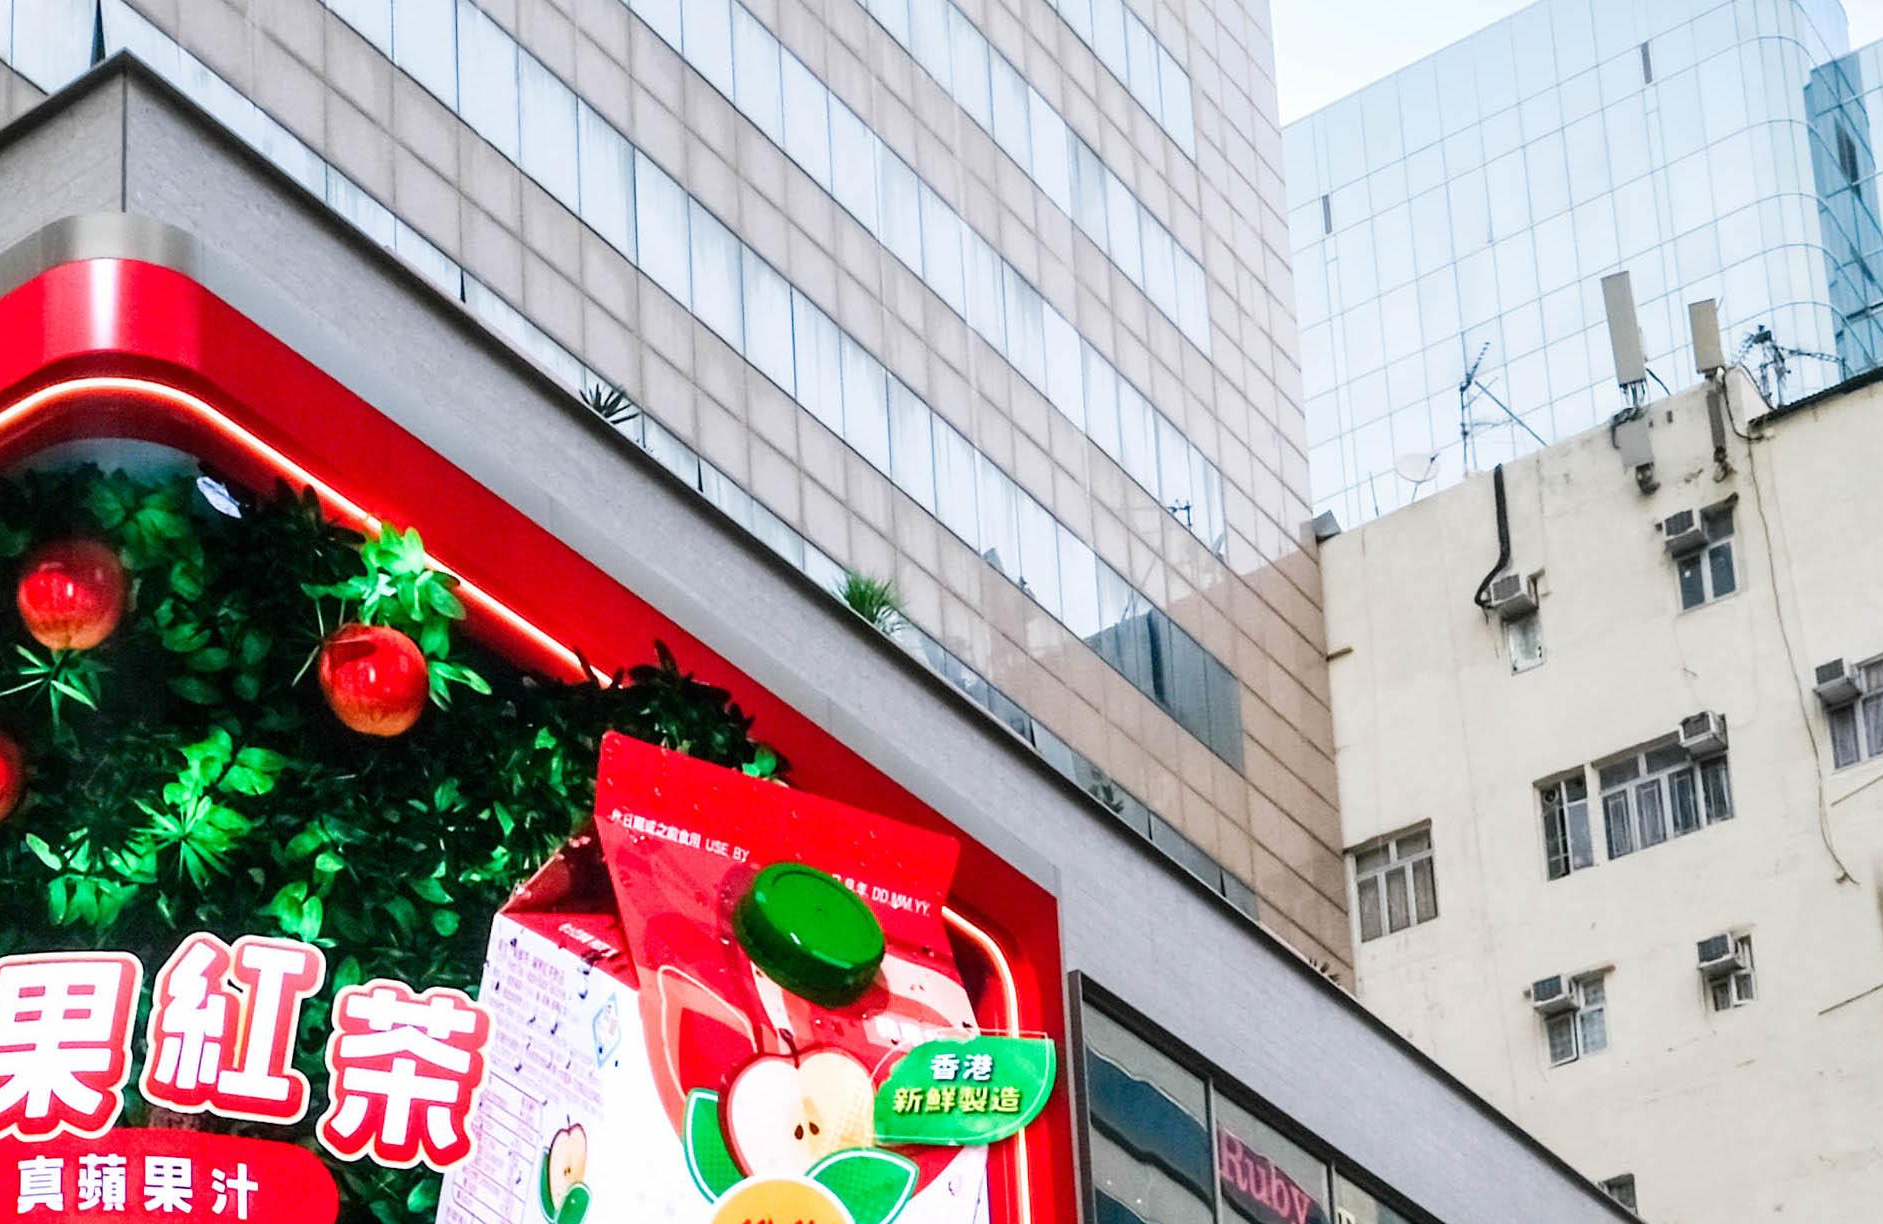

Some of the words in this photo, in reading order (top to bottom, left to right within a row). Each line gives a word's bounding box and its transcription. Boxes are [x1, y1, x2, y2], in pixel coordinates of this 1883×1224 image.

[705, 838, 730, 857] USE
[733, 846, 750, 863] BY
[930, 1053, 994, 1082] 香港
[892, 1085, 1022, 1115] 新鮮製造
